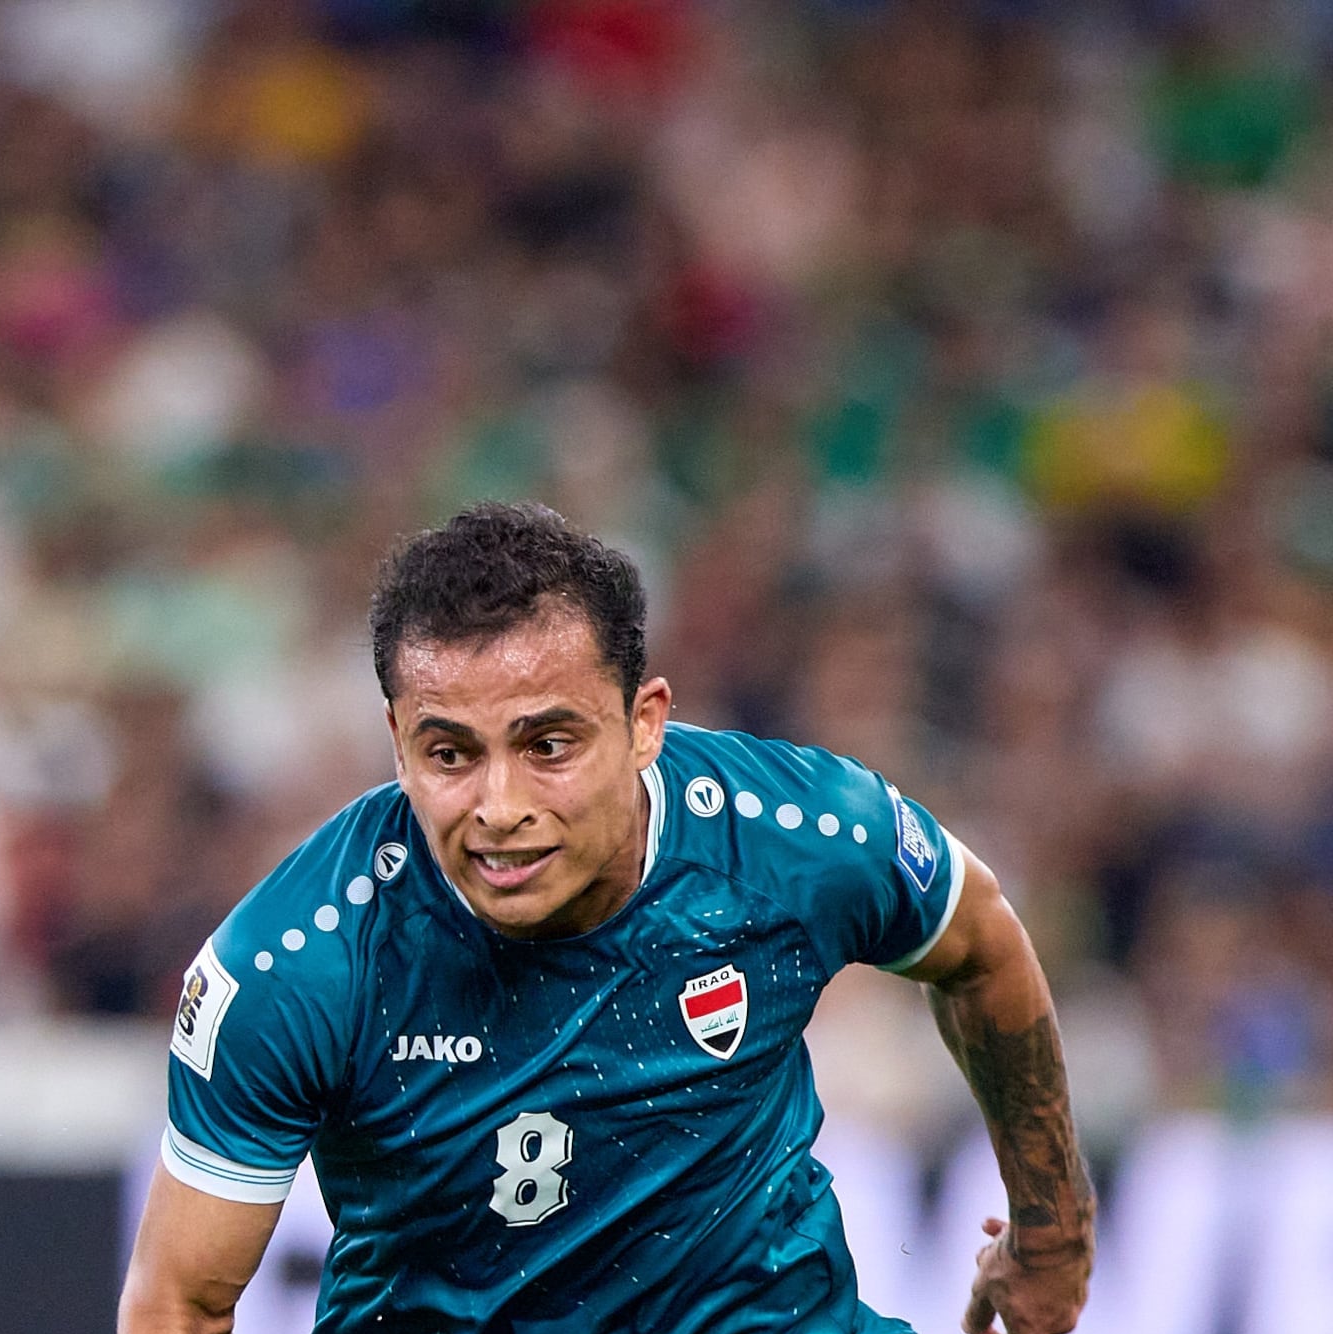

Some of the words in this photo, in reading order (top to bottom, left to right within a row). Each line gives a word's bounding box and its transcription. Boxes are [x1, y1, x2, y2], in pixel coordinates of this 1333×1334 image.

[691, 970, 731, 991] IRAQ
[392, 1035, 483, 1063] JAKO
[488, 1111, 574, 1227] 8
